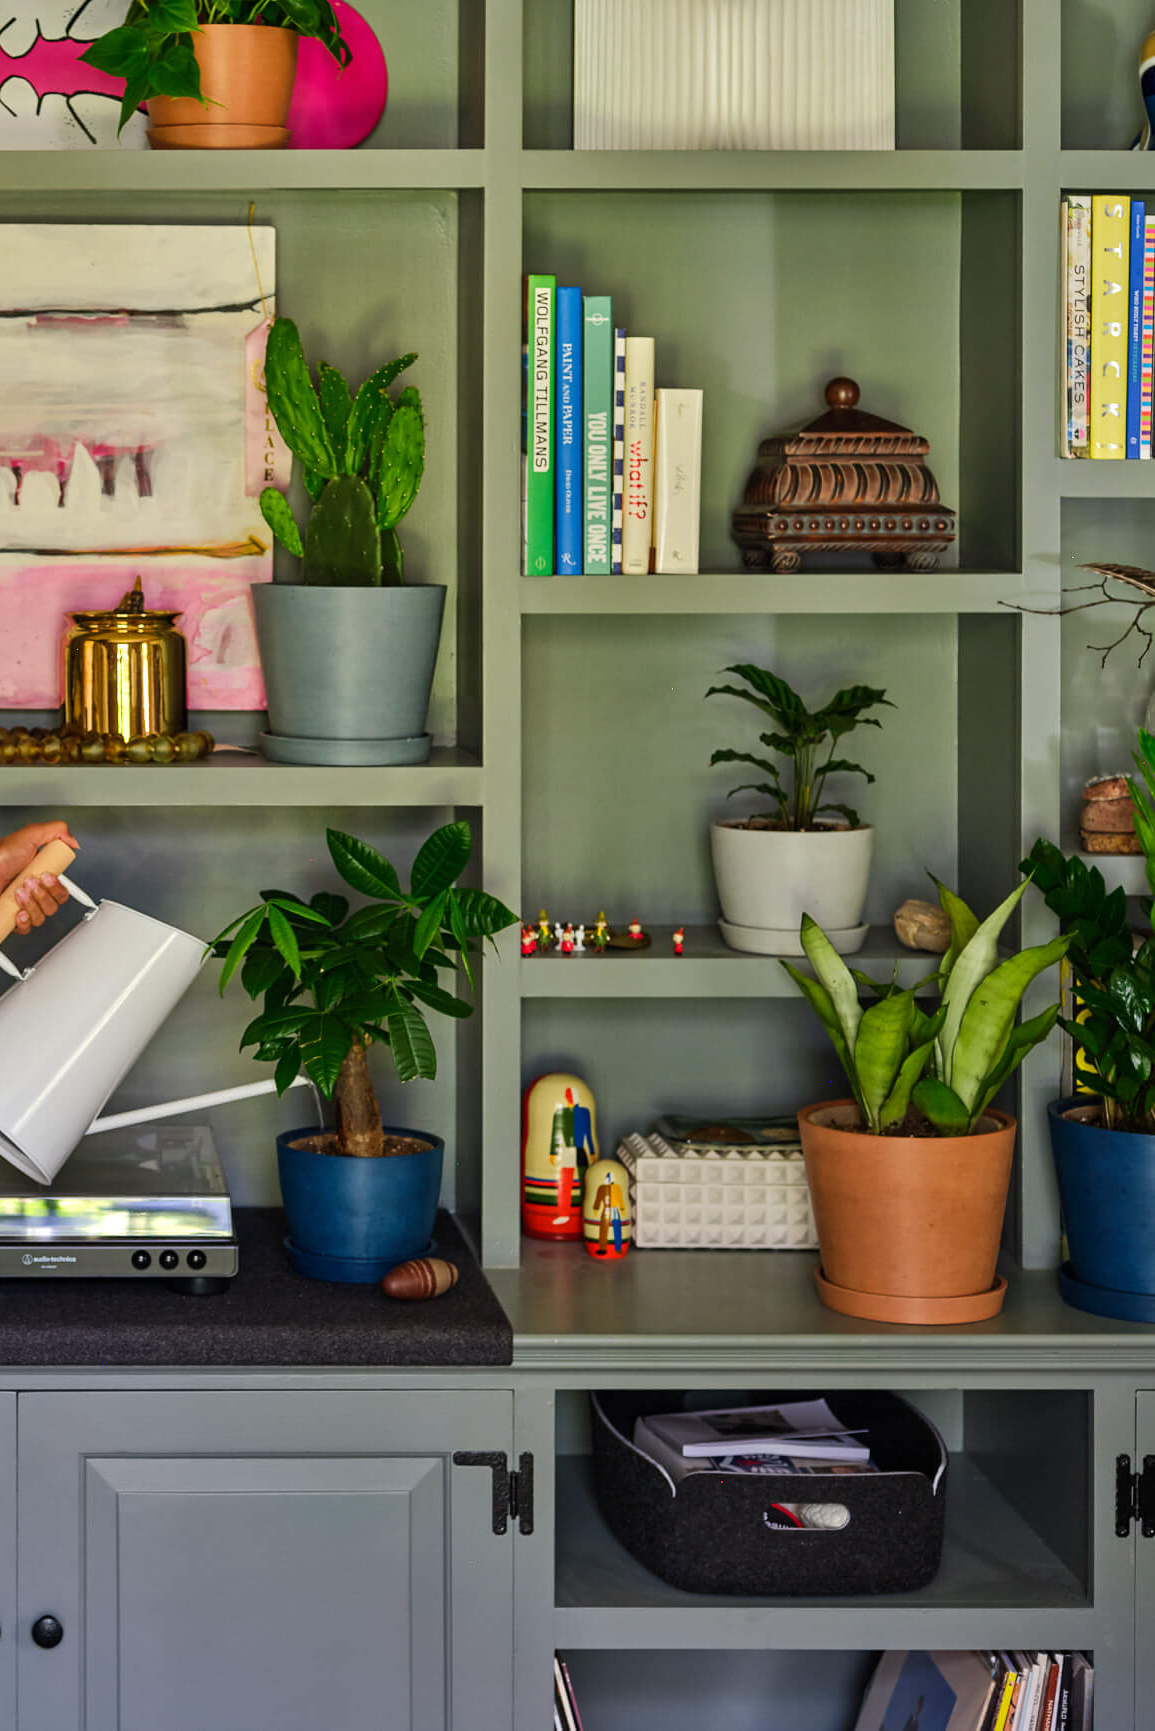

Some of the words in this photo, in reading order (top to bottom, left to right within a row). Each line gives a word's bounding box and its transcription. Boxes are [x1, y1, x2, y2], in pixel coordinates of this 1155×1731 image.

[1074, 265, 1085, 337] STYLISH
[536, 292, 549, 381] WOLFGANG
[562, 343, 573, 382] PAINT
[1074, 344, 1085, 404] CAKES
[562, 384, 571, 405] AND
[639, 381, 647, 430] RANDALL
[535, 388, 548, 468] TILLMANS
[562, 405, 573, 445] PAPER
[588, 412, 607, 441] YOU
[587, 444, 607, 481] ONLY
[629, 441, 648, 489] what
[587, 486, 607, 520] LIVE
[629, 495, 648, 519] if?
[587, 524, 607, 563] ONCE
